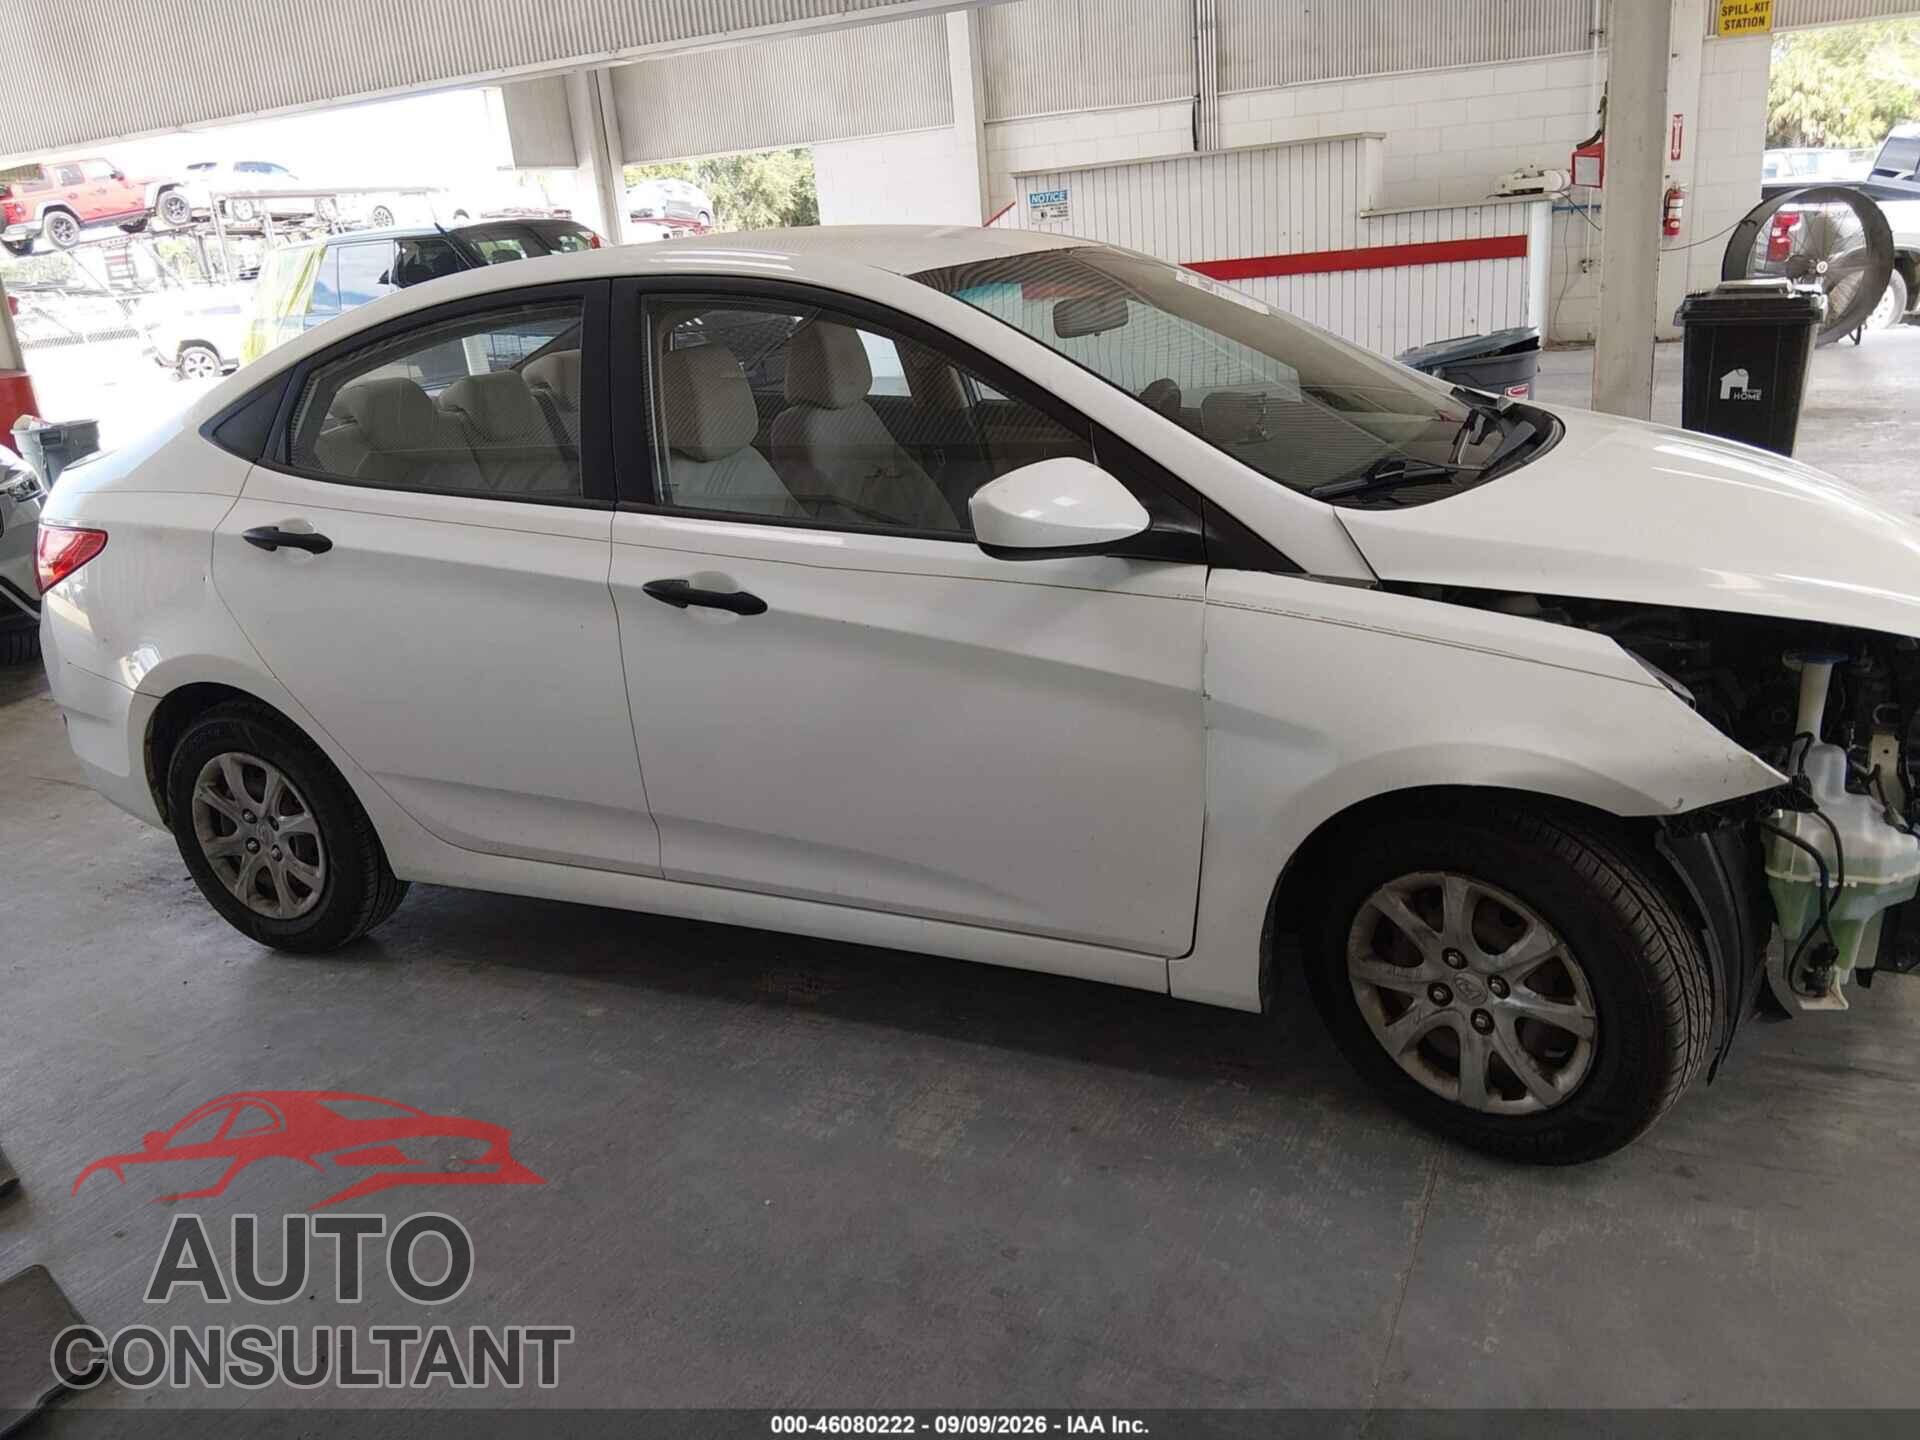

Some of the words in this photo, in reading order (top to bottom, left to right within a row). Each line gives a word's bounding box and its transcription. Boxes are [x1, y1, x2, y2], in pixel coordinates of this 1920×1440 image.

[1721, 1, 1770, 16] SPILL-KIT
[1724, 16, 1765, 30] STATION
[1031, 191, 1065, 203] NOTICE
[1733, 391, 1761, 400] HOME
